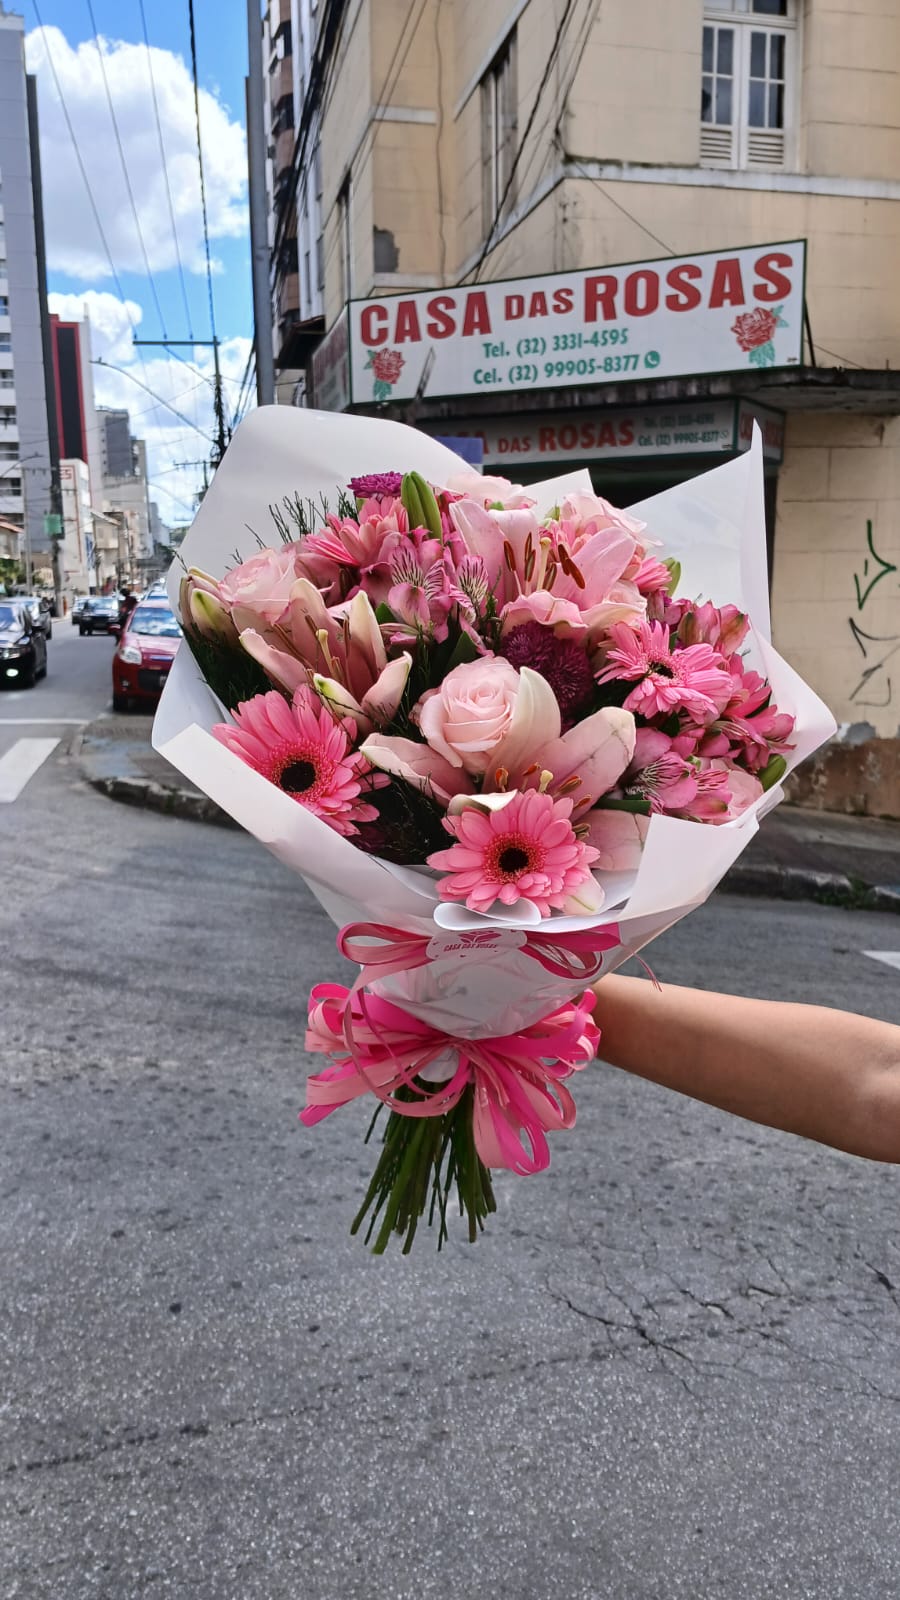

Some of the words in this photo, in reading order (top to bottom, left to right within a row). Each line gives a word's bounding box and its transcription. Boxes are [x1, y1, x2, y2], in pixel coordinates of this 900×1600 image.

[360, 291, 492, 347] CASA
[505, 288, 574, 321] DAS
[583, 252, 794, 323] ROSAS
[482, 341, 510, 359] Tel.
[516, 336, 547, 358] (32)
[552, 328, 629, 352] 3331-4595
[473, 367, 503, 385] Cel.
[508, 364, 539, 385] (32)
[544, 354, 640, 378] 99905-8377
[498, 437, 531, 453] DAS
[539, 418, 635, 453] ROSAS
